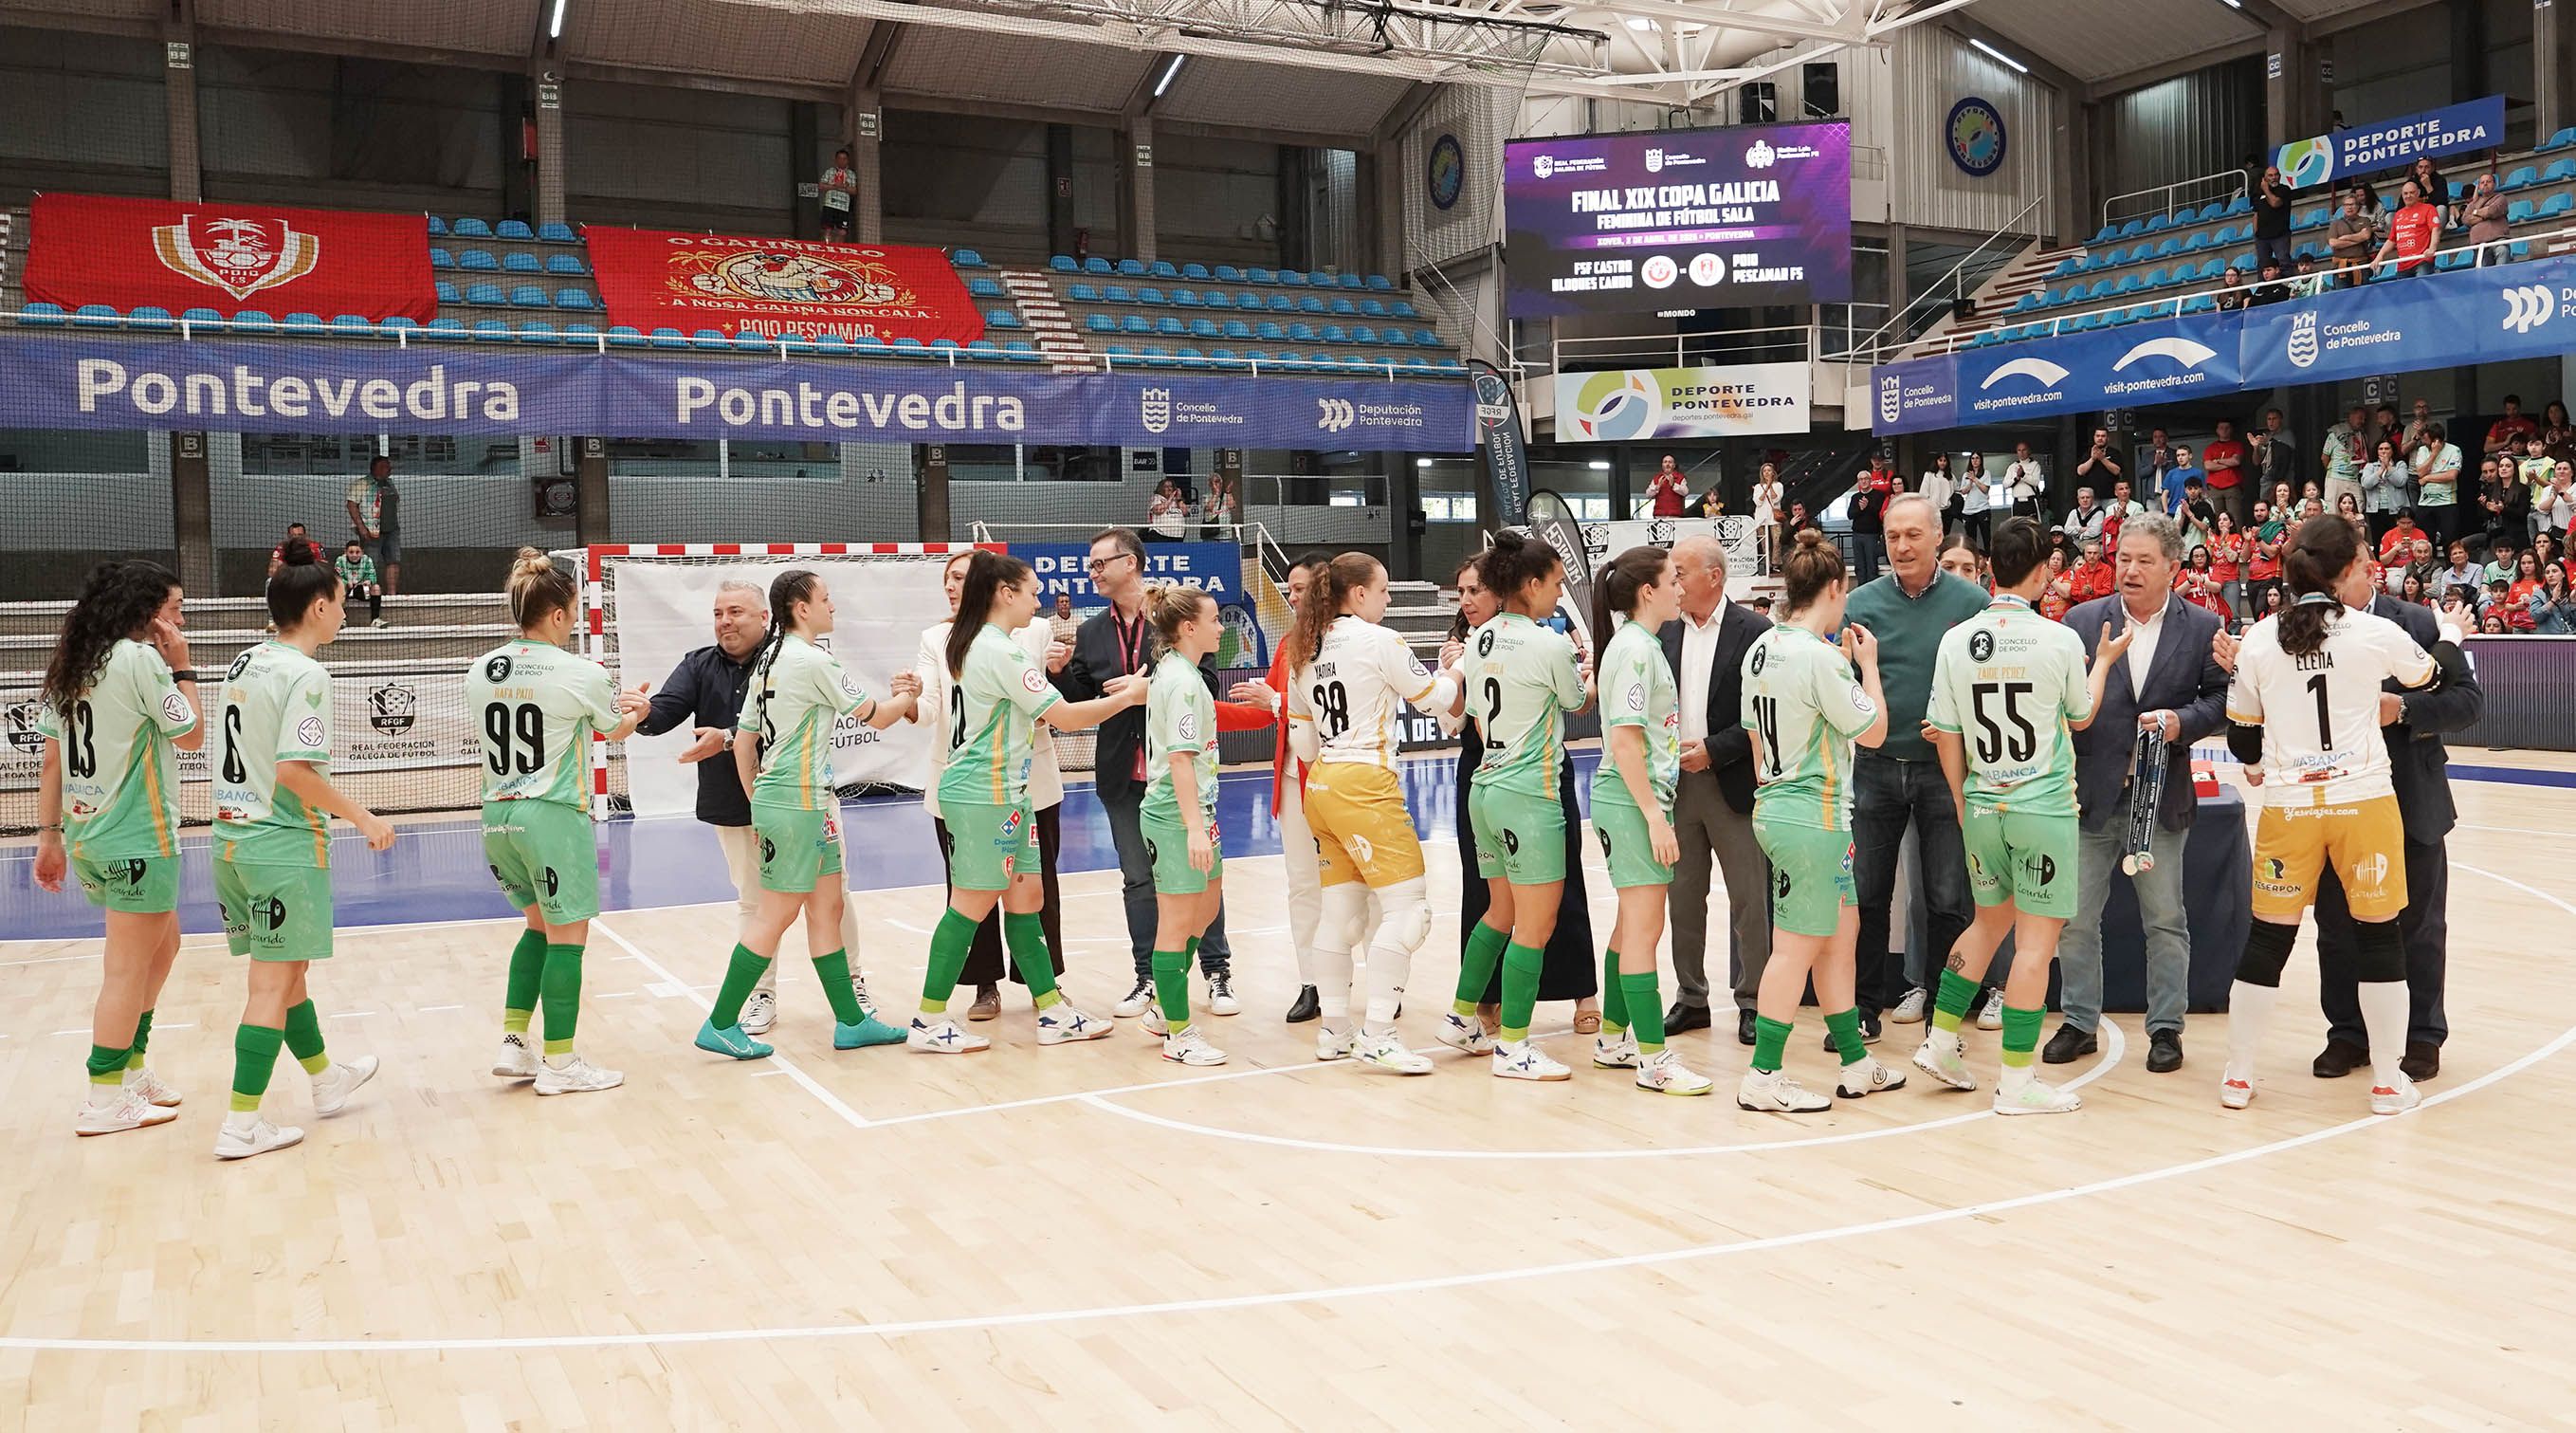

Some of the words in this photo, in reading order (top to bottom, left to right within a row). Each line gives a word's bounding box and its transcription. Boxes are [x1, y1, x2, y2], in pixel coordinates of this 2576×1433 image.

[2268, 62, 2280, 71] CC
[2344, 119, 2440, 153] DEPORTE
[2344, 125, 2487, 168] PONTEVEDRA
[1571, 189, 1622, 213] FINAL
[1624, 188, 1655, 211] XIX
[1658, 184, 1707, 208] COPA
[1708, 180, 1781, 204] GALICIA
[1597, 210, 1653, 230] FEMININA
[1655, 210, 1672, 227] DE
[1672, 208, 1720, 226] FÚTBOL
[1722, 206, 1754, 223] SALA
[1574, 262, 1593, 275] FSF
[1594, 259, 1633, 274] CASTRO
[1732, 253, 1759, 267] POIO
[219, 268, 259, 277] POIO
[1732, 267, 1789, 284] PESCAMAR
[1790, 266, 1803, 280] FS
[1552, 277, 1598, 292] BLOQUES
[672, 298, 687, 307] A
[691, 299, 749, 310] NOSA
[832, 307, 870, 317] NON
[1664, 309, 1696, 318] MONDO
[740, 318, 781, 337] POIO
[786, 320, 875, 339] PESCAMAR
[2323, 320, 2370, 337] Concello
[2326, 338, 2340, 350] de
[2341, 330, 2402, 348] Pontevedra
[77, 358, 520, 420] Pontevedra
[1672, 384, 1755, 396] DEPORTE
[1904, 384, 1934, 396] Concello
[2104, 371, 2205, 395] visit-pontevedra.com
[2366, 383, 2378, 396] C
[2386, 380, 2397, 394] C
[677, 377, 1025, 432] Pontevedra
[1176, 402, 1216, 412] Concello
[1672, 396, 1795, 410] PONTEVEDRA
[1904, 398, 1913, 409] de
[1914, 394, 1952, 408] Pontevedra
[1973, 390, 2063, 411] visit-pontevedra.com
[1359, 404, 1422, 415] Deputación
[1176, 413, 1189, 423] de
[1190, 413, 1244, 424] Pontevedra
[1359, 415, 1423, 426] Pontevedra
[2107, 413, 2114, 425] C
[2124, 412, 2132, 424] C
[184, 436, 198, 450] B
[588, 438, 601, 450] B
[932, 447, 942, 460] B
[1229, 452, 1236, 463] B
[1884, 447, 1891, 458] C
[1588, 544, 1602, 553] RFGF
[1035, 555, 1191, 574] DERTE
[515, 664, 555, 672] CONCELLO
[1484, 676, 1507, 749] 2
[2307, 673, 2333, 751] 1
[381, 718, 406, 726] RFGF
[1412, 716, 1437, 743] DE
[1971, 682, 2037, 764] 55
[68, 700, 97, 780] 13
[484, 702, 545, 776] 99
[1752, 694, 1783, 777] 14
[222, 704, 247, 784] 6
[352, 744, 375, 752] REAL
[377, 740, 435, 749] FEDERACIÓN
[349, 752, 386, 761] GALEGA
[388, 750, 400, 759] DE
[402, 747, 437, 757] FÚTBOL
[1983, 765, 2038, 781] ABANCA
[2283, 806, 2359, 821] Yesviajes.com
